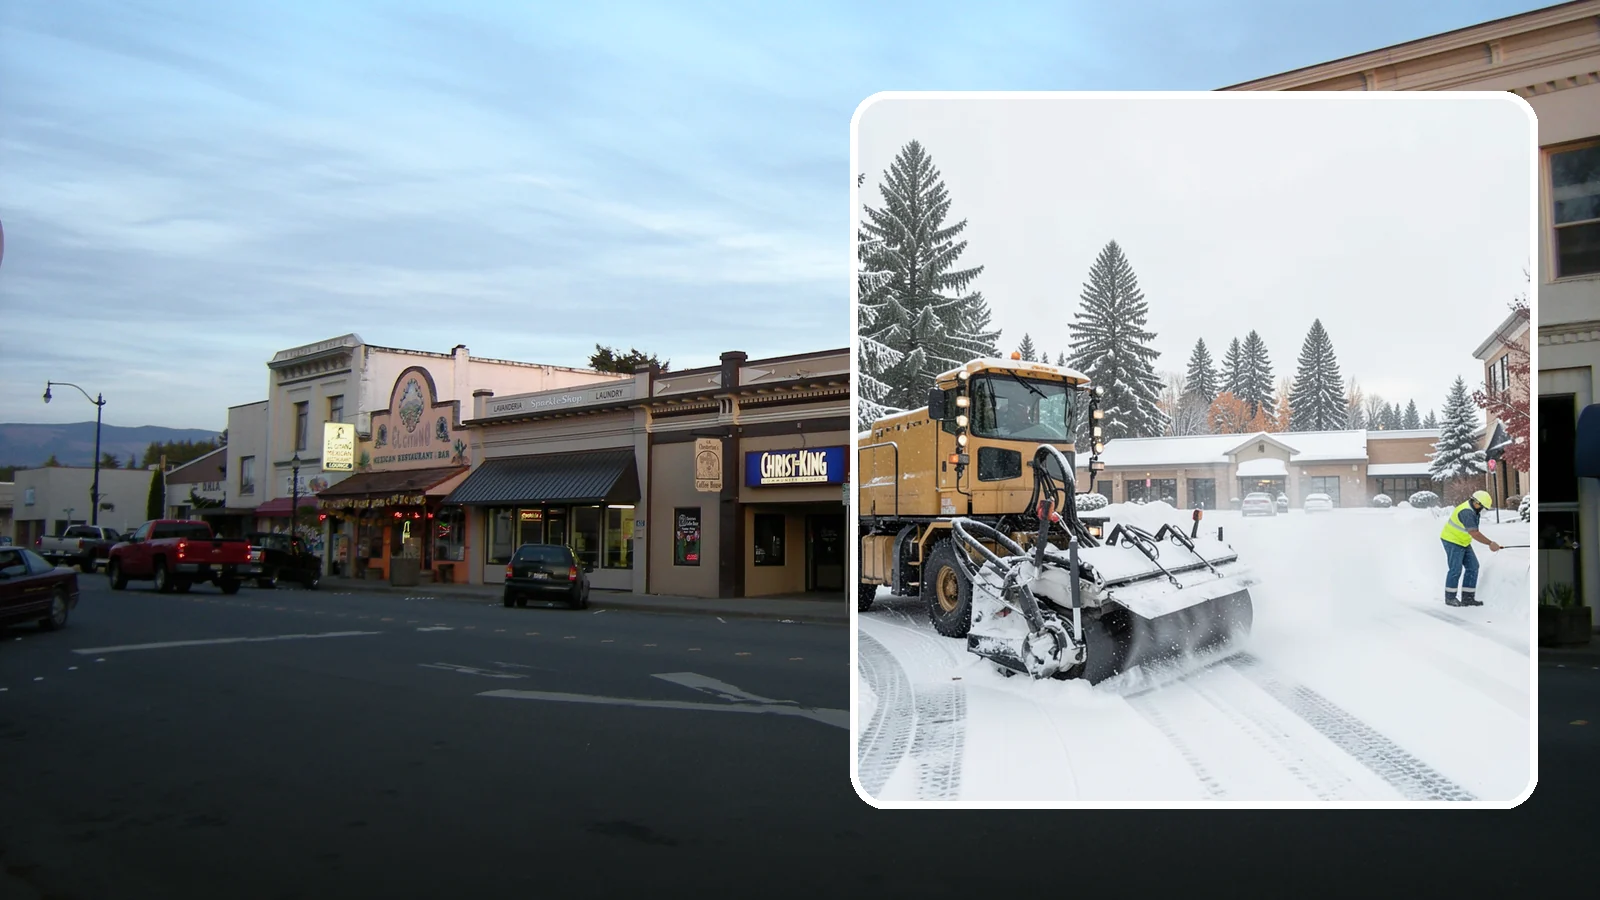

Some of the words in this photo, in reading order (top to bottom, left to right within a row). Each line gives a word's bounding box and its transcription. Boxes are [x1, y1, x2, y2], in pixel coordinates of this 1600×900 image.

[561, 394, 583, 405] Shop
[595, 389, 623, 400] LAUNDRY
[493, 402, 523, 412] LAVANDERIA
[397, 451, 433, 463] RESTAURANT
[438, 450, 450, 459] BAR
[760, 452, 797, 478] CHRIST
[799, 450, 827, 476] KING
